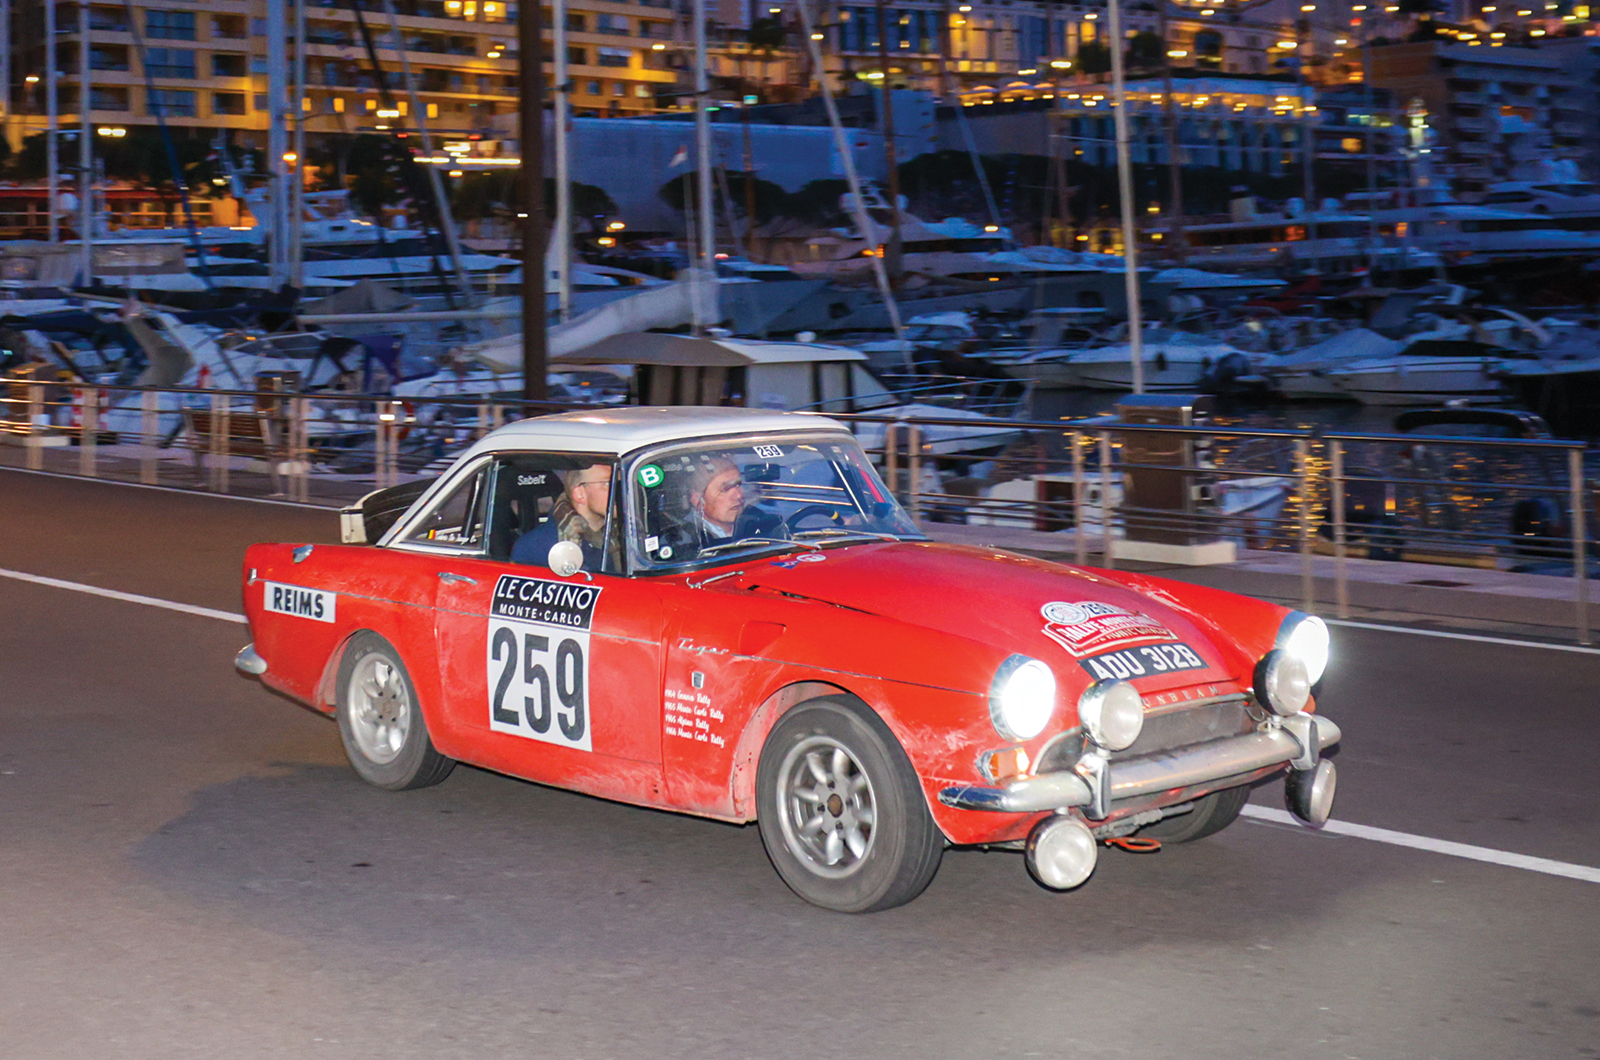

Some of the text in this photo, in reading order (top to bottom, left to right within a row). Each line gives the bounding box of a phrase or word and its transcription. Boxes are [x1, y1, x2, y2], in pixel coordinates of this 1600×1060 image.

[757, 446, 780, 457] 259
[640, 467, 660, 486] B
[273, 586, 324, 618] REIMS
[497, 578, 593, 610] LE CASINO
[1056, 620, 1105, 643] RALLYE
[1088, 644, 1202, 680] ADU 312B
[492, 627, 585, 741] 259
[697, 693, 711, 708] Rally
[1141, 685, 1219, 708] UNBEAM
[696, 717, 710, 733] Rally
[710, 708, 724, 723] Rally
[711, 733, 725, 749] Rally
